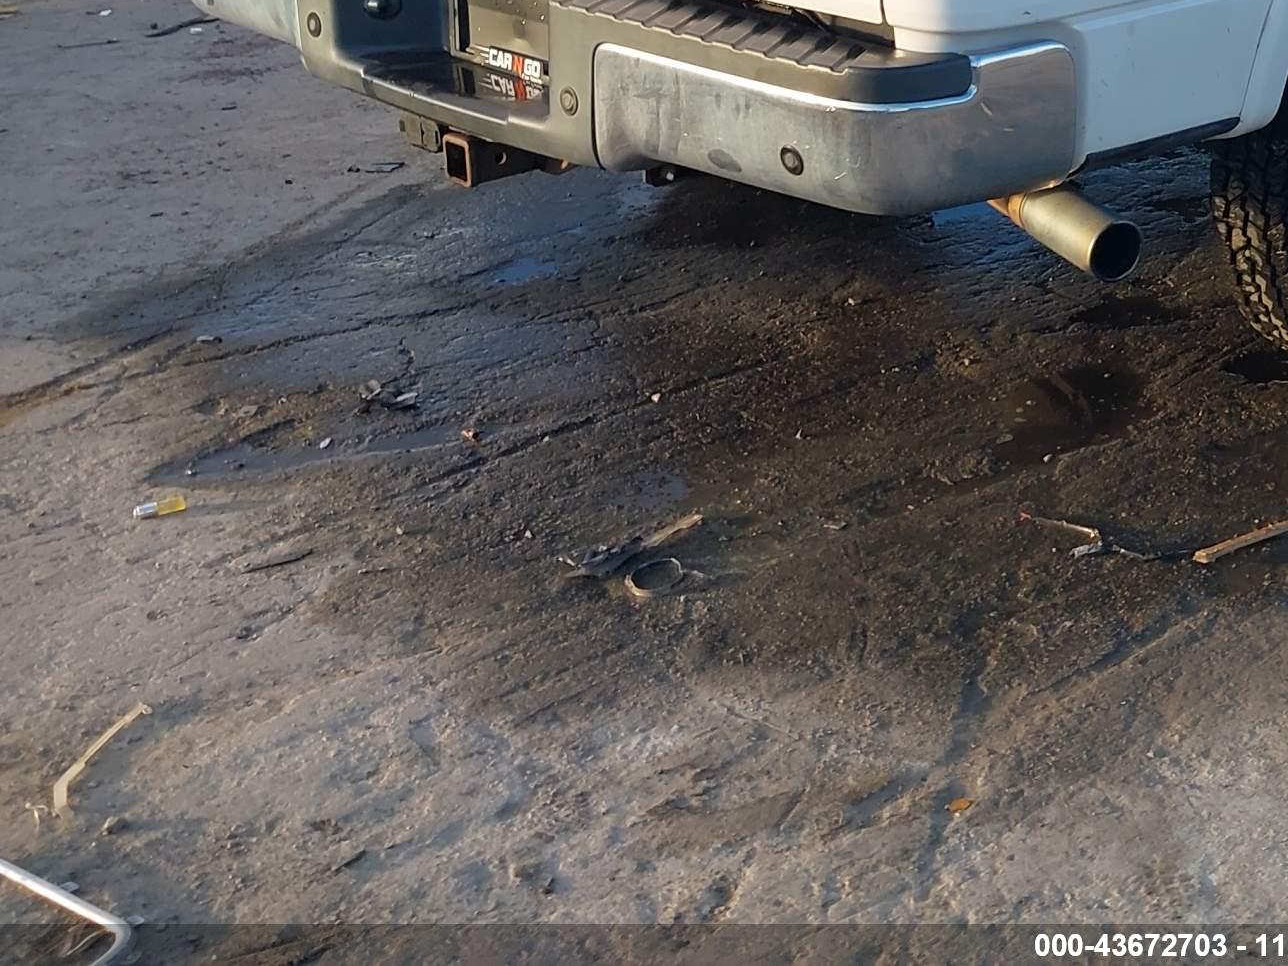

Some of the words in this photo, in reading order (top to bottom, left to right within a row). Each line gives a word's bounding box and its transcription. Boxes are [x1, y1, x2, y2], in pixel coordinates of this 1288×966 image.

[488, 47, 513, 71] CAR
[512, 53, 525, 76] N
[524, 58, 541, 79] GO
